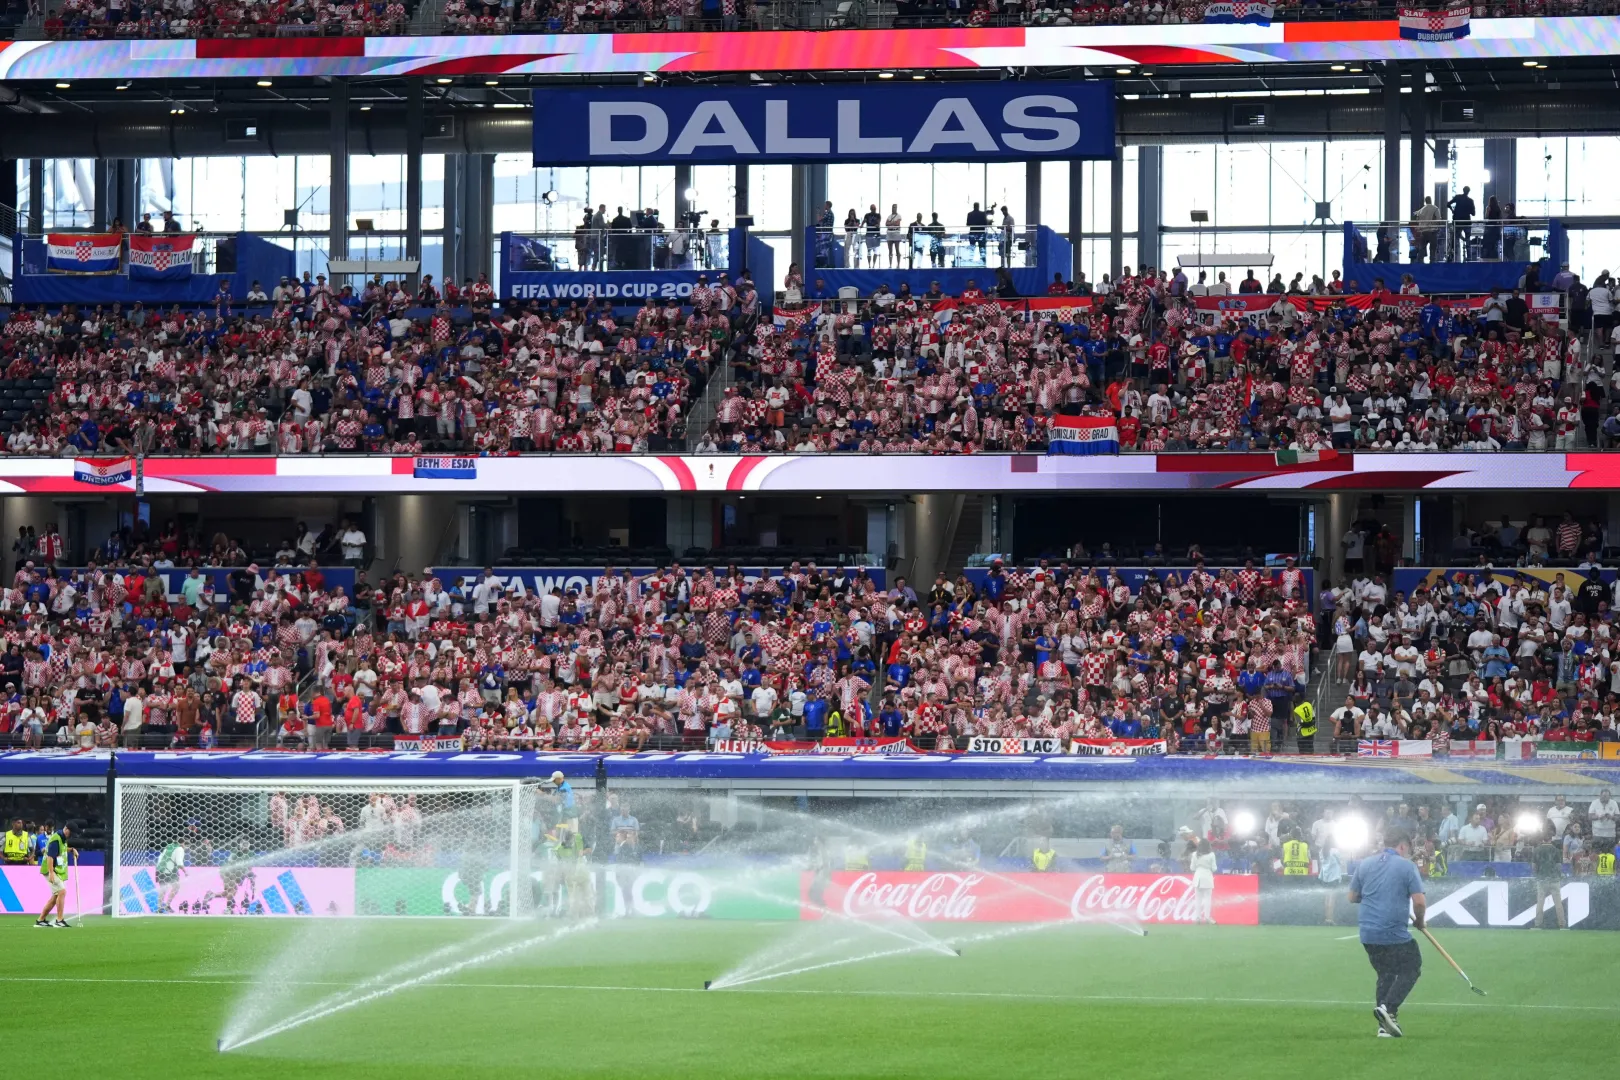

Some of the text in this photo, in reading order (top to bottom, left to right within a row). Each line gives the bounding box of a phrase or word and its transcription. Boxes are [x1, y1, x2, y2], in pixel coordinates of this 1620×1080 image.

[1418, 32, 1454, 40] DUBROVNIK
[589, 95, 1080, 156] DALLAS
[512, 283, 722, 298] FIFA WORLD CUP 206
[1157, 350, 1166, 360] 17
[1092, 428, 1108, 439] GRAD
[417, 458, 475, 468] BETH ESDA
[437, 740, 459, 749] NEC
[974, 739, 1053, 752] STO LAC
[843, 872, 984, 919] Coca-Cola
